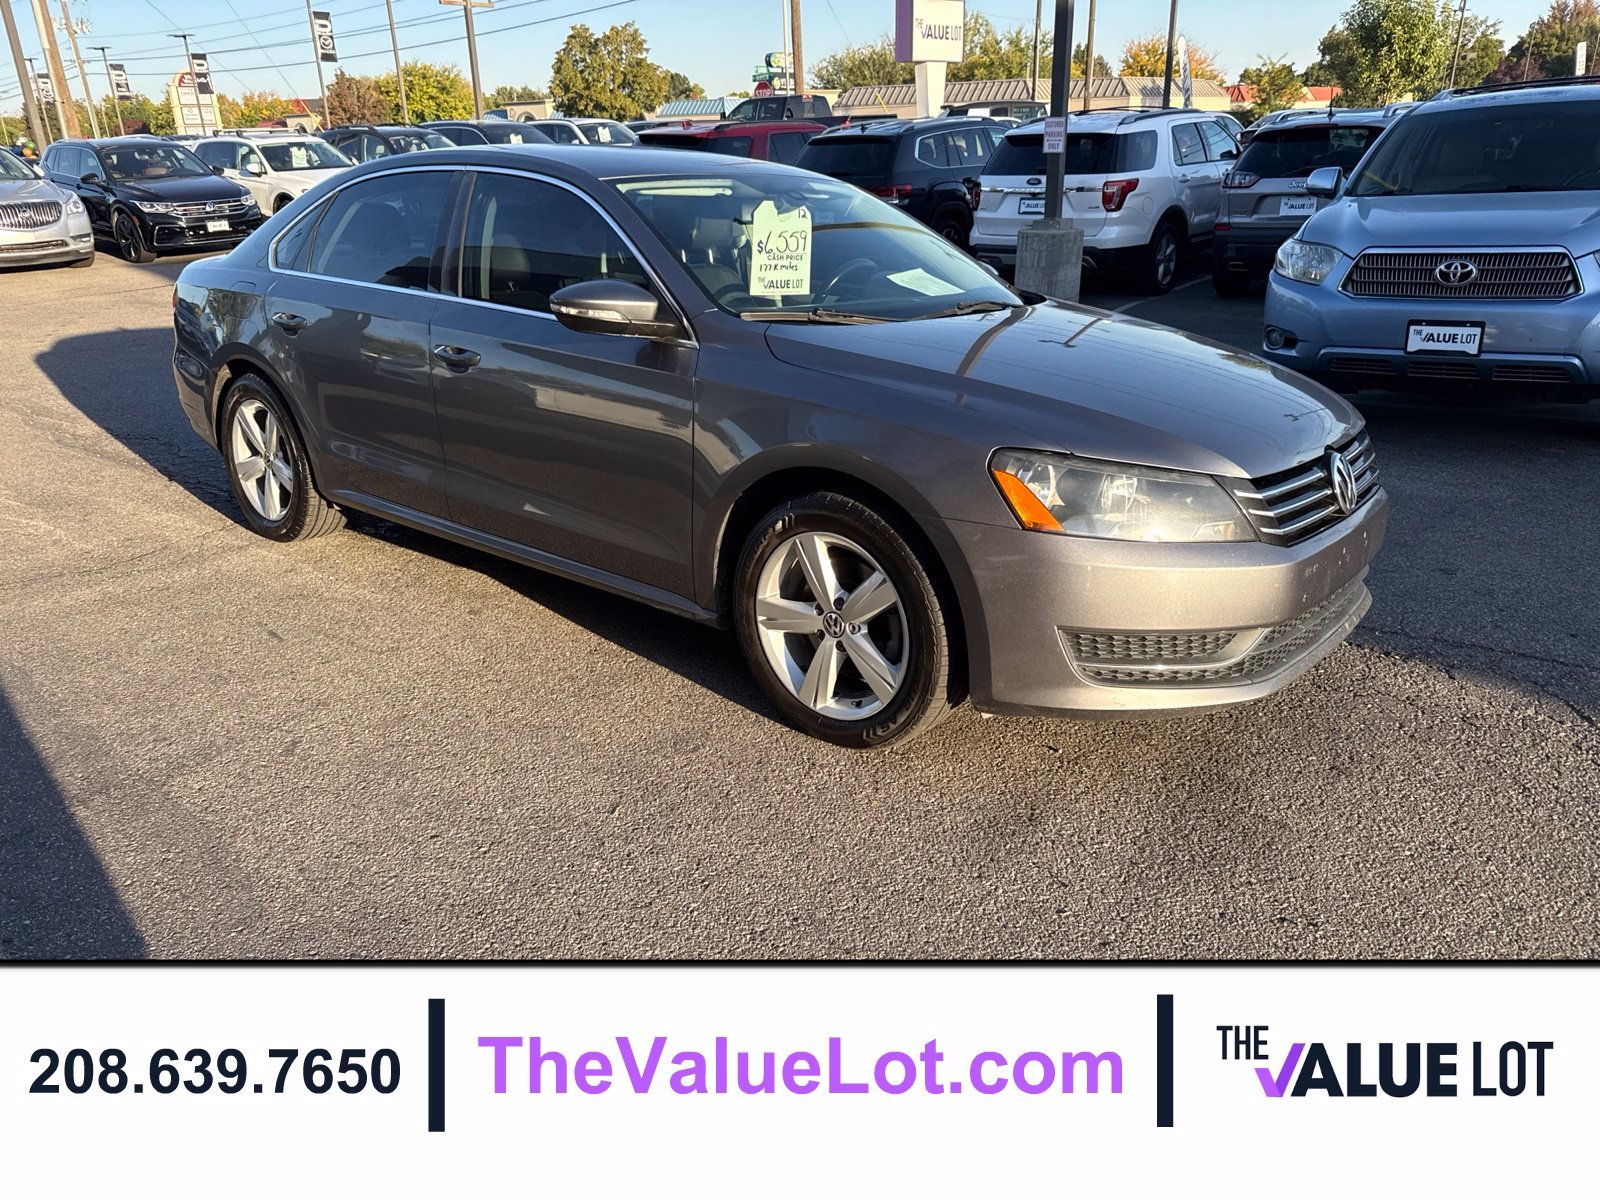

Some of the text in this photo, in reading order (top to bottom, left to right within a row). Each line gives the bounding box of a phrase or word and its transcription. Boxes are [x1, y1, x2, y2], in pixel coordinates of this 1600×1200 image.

[915, 18, 962, 41] THE VALUE LOT
[755, 89, 771, 97] STOP
[1046, 120, 1064, 128] CUSTOMER
[798, 208, 808, 219] 12
[780, 261, 798, 271] miles
[763, 279, 790, 289] VALUE
[792, 279, 804, 289] LOT
[1420, 332, 1459, 343] VALUE
[1460, 333, 1478, 344] LOT
